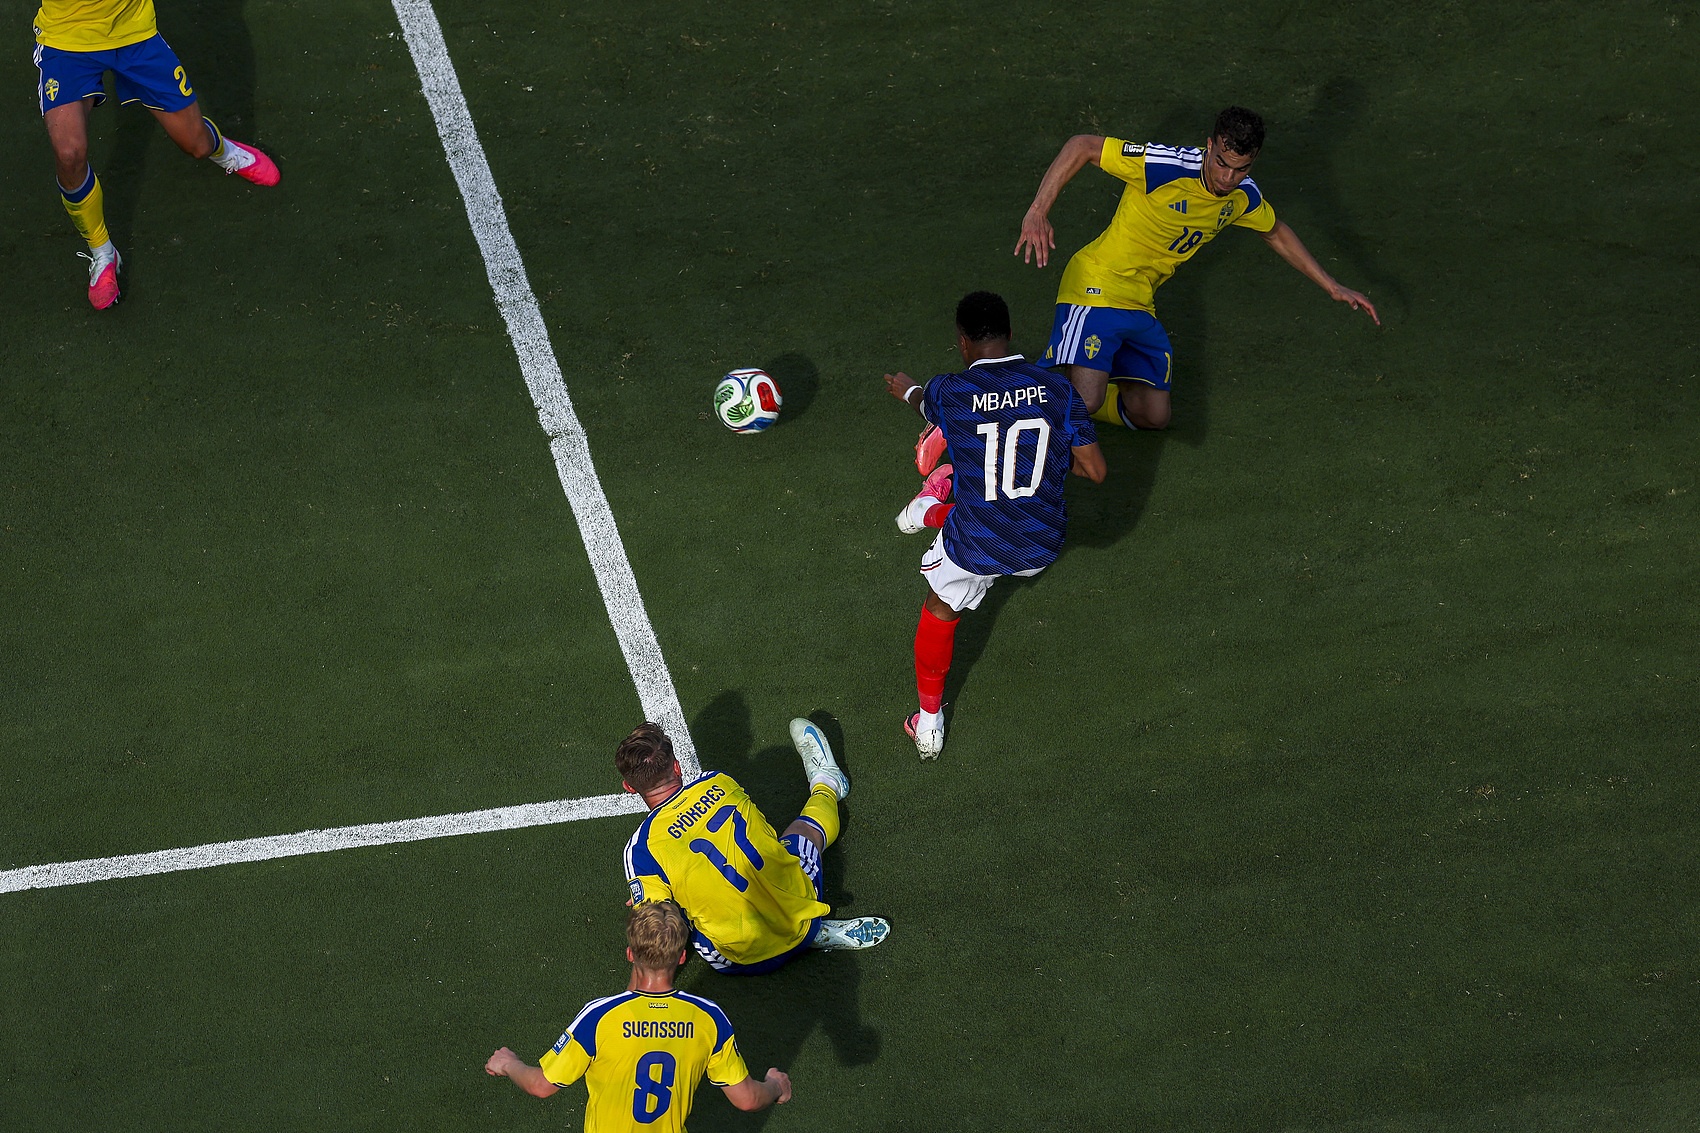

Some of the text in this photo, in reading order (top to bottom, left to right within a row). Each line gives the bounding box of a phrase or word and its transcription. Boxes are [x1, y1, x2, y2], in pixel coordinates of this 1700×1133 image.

[174, 65, 193, 96] 2
[1168, 227, 1204, 254] 18
[1164, 352, 1173, 384] 1
[972, 385, 1048, 413] MBAPPE
[977, 417, 1051, 502] 10
[668, 784, 726, 839] GYÖKERES
[689, 805, 764, 893] 17
[623, 1021, 694, 1039] SVENSSON
[632, 1050, 677, 1124] 8
